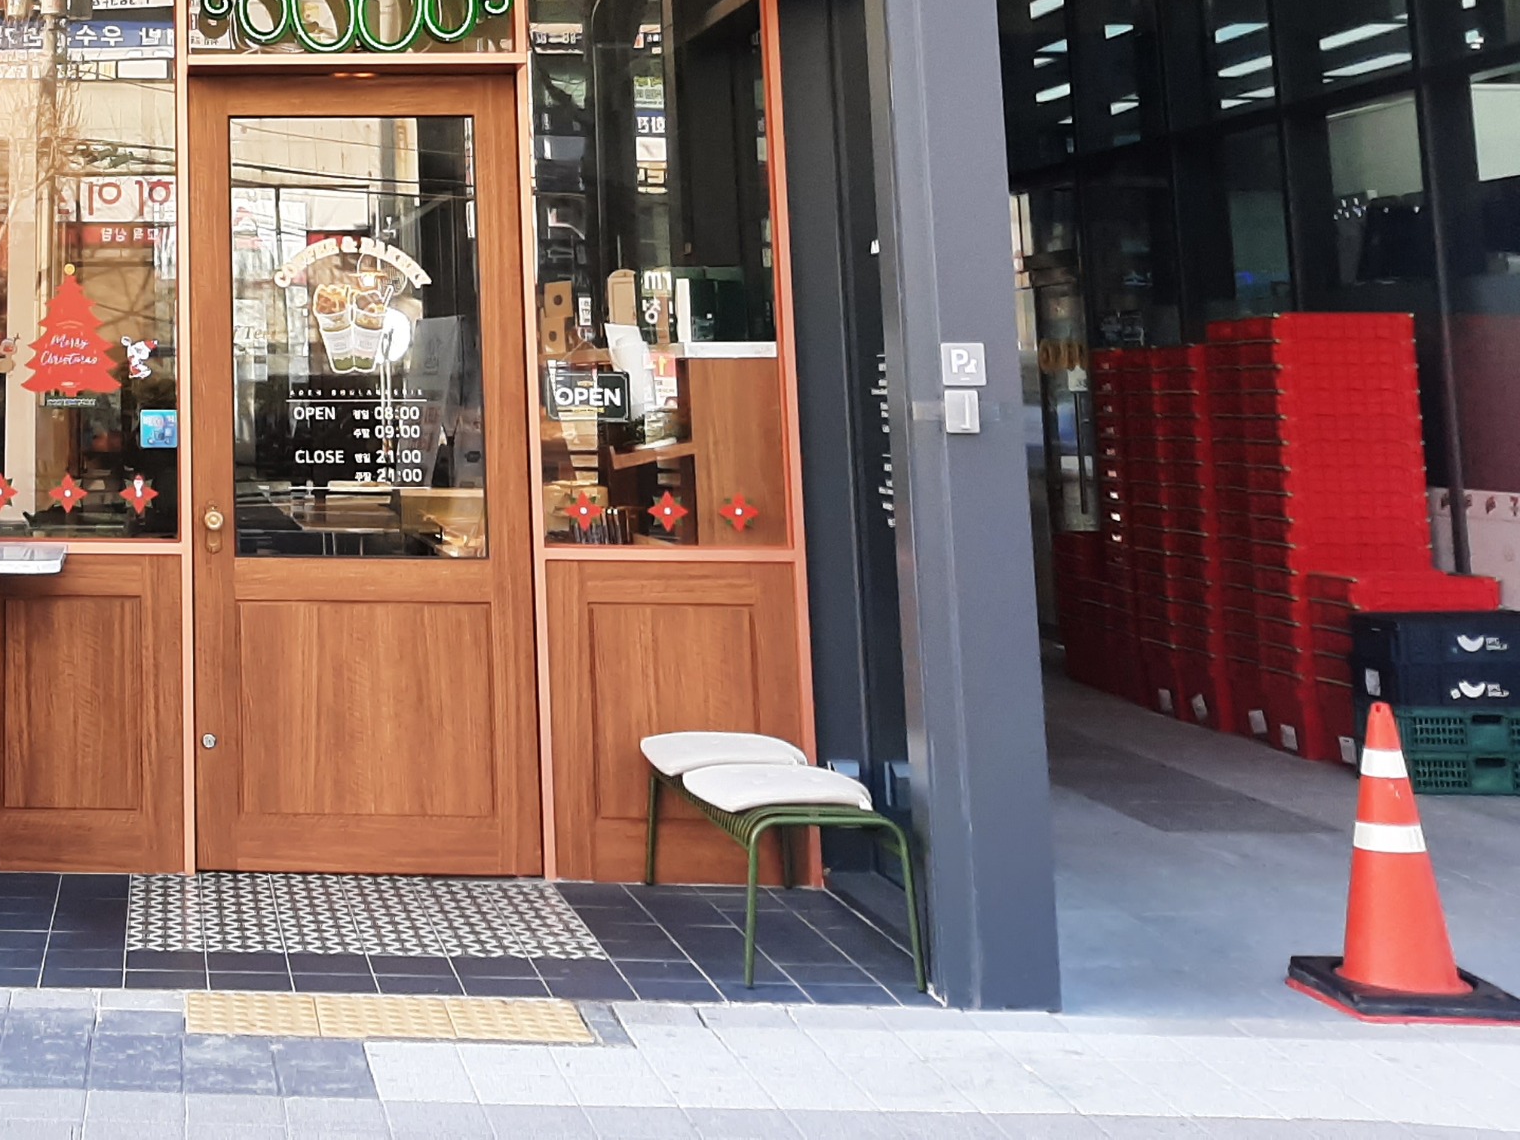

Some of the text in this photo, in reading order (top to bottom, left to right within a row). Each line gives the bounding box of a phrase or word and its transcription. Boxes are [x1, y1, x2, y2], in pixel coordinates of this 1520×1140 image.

[51, 332, 88, 350] Merry
[41, 351, 98, 366] Christmas
[555, 387, 622, 407] OPEN
[293, 406, 336, 421] OPEN
[374, 406, 421, 421] 08:00
[374, 424, 421, 440] 09:00
[294, 449, 346, 465] CLOSE
[375, 449, 423, 465] 21:00
